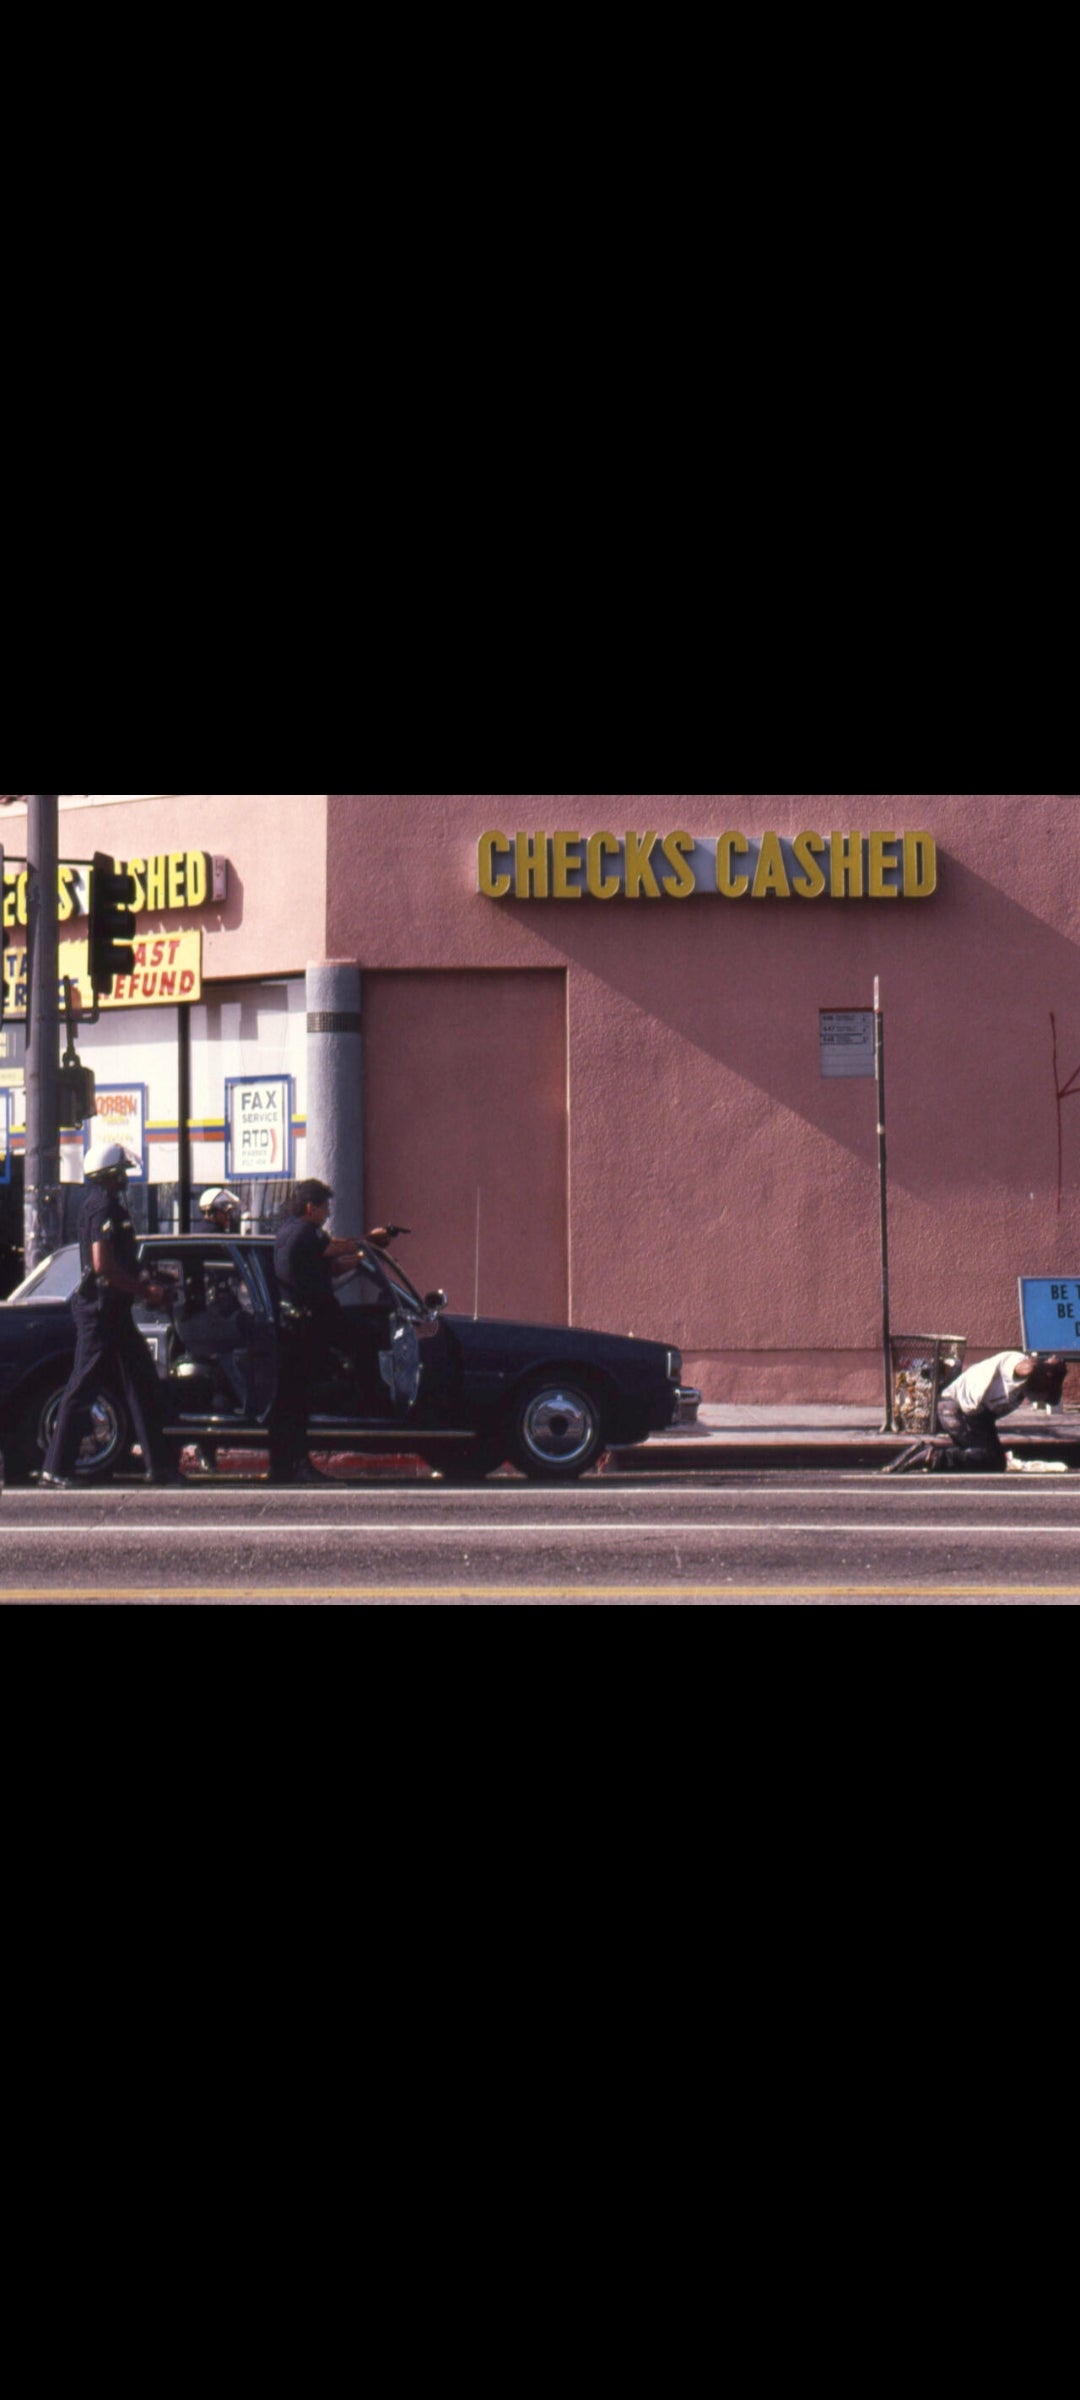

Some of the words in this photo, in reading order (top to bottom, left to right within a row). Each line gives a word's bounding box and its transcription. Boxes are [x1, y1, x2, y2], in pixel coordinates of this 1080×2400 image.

[477, 830, 696, 899] CHECKS
[715, 830, 937, 898] CASHED
[88, 851, 207, 913] SHED
[133, 940, 181, 968] AST
[98, 970, 196, 1000] EFUND
[241, 1090, 277, 1110] FAX
[242, 1112, 278, 1123] SERVICE
[242, 1129, 269, 1148] RTD
[1051, 1284, 1069, 1300] BE
[1057, 1303, 1075, 1319] BE
